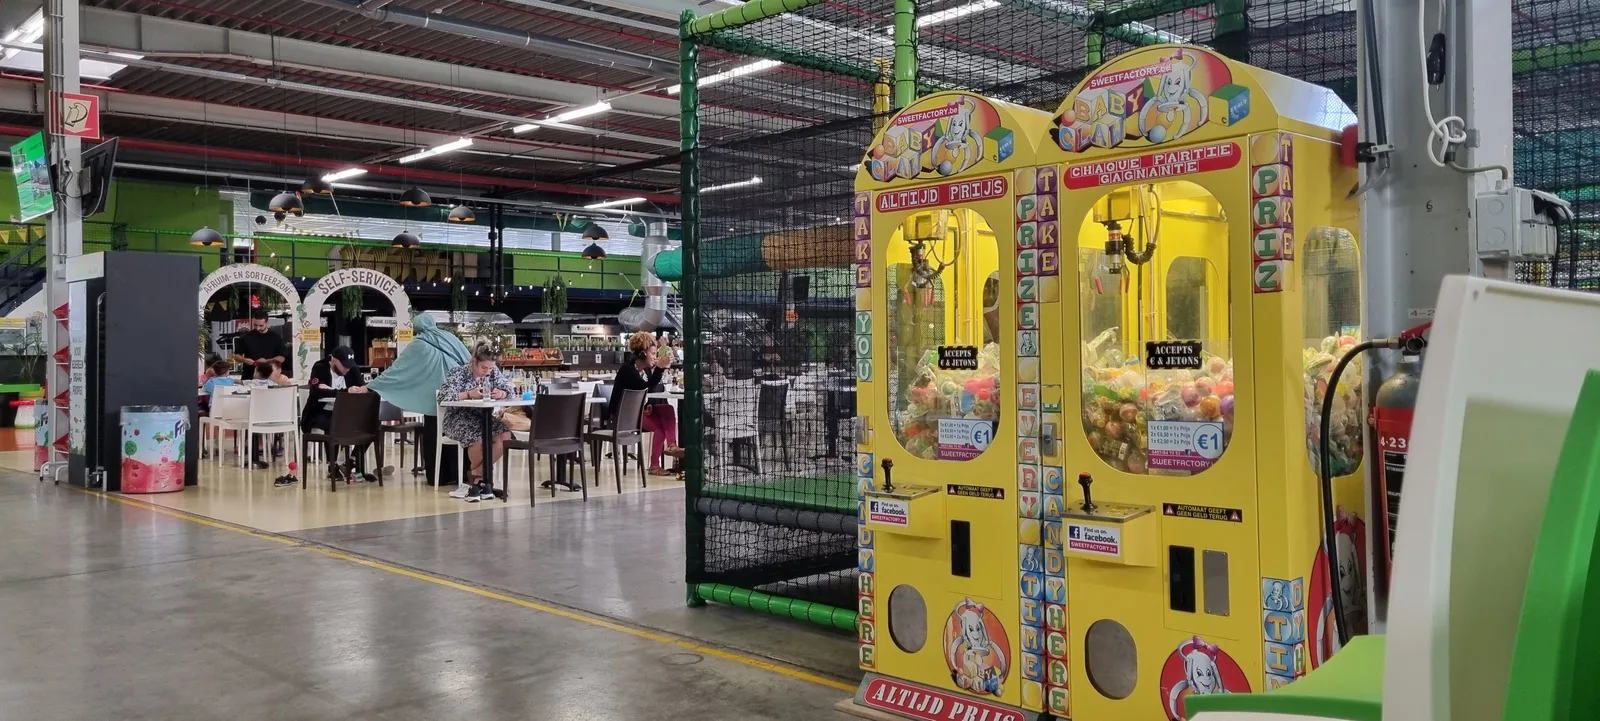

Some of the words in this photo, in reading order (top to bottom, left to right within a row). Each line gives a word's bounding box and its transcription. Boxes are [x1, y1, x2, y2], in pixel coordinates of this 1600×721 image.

[1090, 61, 1172, 88] SWEETFACTORY.be
[897, 107, 958, 125] SWEETFACTORY.be
[1074, 87, 1144, 125] BABY
[883, 127, 936, 156] BABY
[1059, 119, 1125, 151] CLAW
[871, 149, 921, 182] CLAW
[1072, 157, 1140, 178] CHAQUE
[1154, 144, 1231, 165] PARTIE
[1100, 161, 1198, 184] GAGNANTE
[881, 191, 939, 209] ALTIJD
[950, 179, 1004, 200] PRIJS
[1281, 139, 1292, 255] TAKE
[1040, 171, 1055, 272] TAKE
[857, 196, 870, 284] TAKE
[1020, 198, 1035, 326] PRIZE
[233, 270, 243, 279] EN
[245, 270, 294, 297] SORTEERZONE
[318, 270, 398, 296] SELF-SERVICE
[858, 314, 870, 381] YOU
[940, 359, 944, 367] €
[945, 359, 950, 367] &
[951, 358, 976, 367] JETONS
[1150, 357, 1156, 365] €
[1157, 357, 1164, 365] &
[1166, 356, 1199, 366] JETONS
[1155, 345, 1193, 354] ACCEPTS
[974, 430, 990, 444] €1
[1021, 387, 1036, 518] EVERY
[1198, 433, 1218, 450] €1
[859, 456, 873, 570] CANDY
[1178, 505, 1206, 513] AUTOMAAT
[1046, 470, 1063, 602] CANDY
[1071, 541, 1117, 552] SWEETFACTORY.be
[862, 575, 873, 665] HERE
[1024, 575, 1037, 677] TIME
[1049, 607, 1065, 712] HERE
[872, 684, 944, 714] ALTIJD
